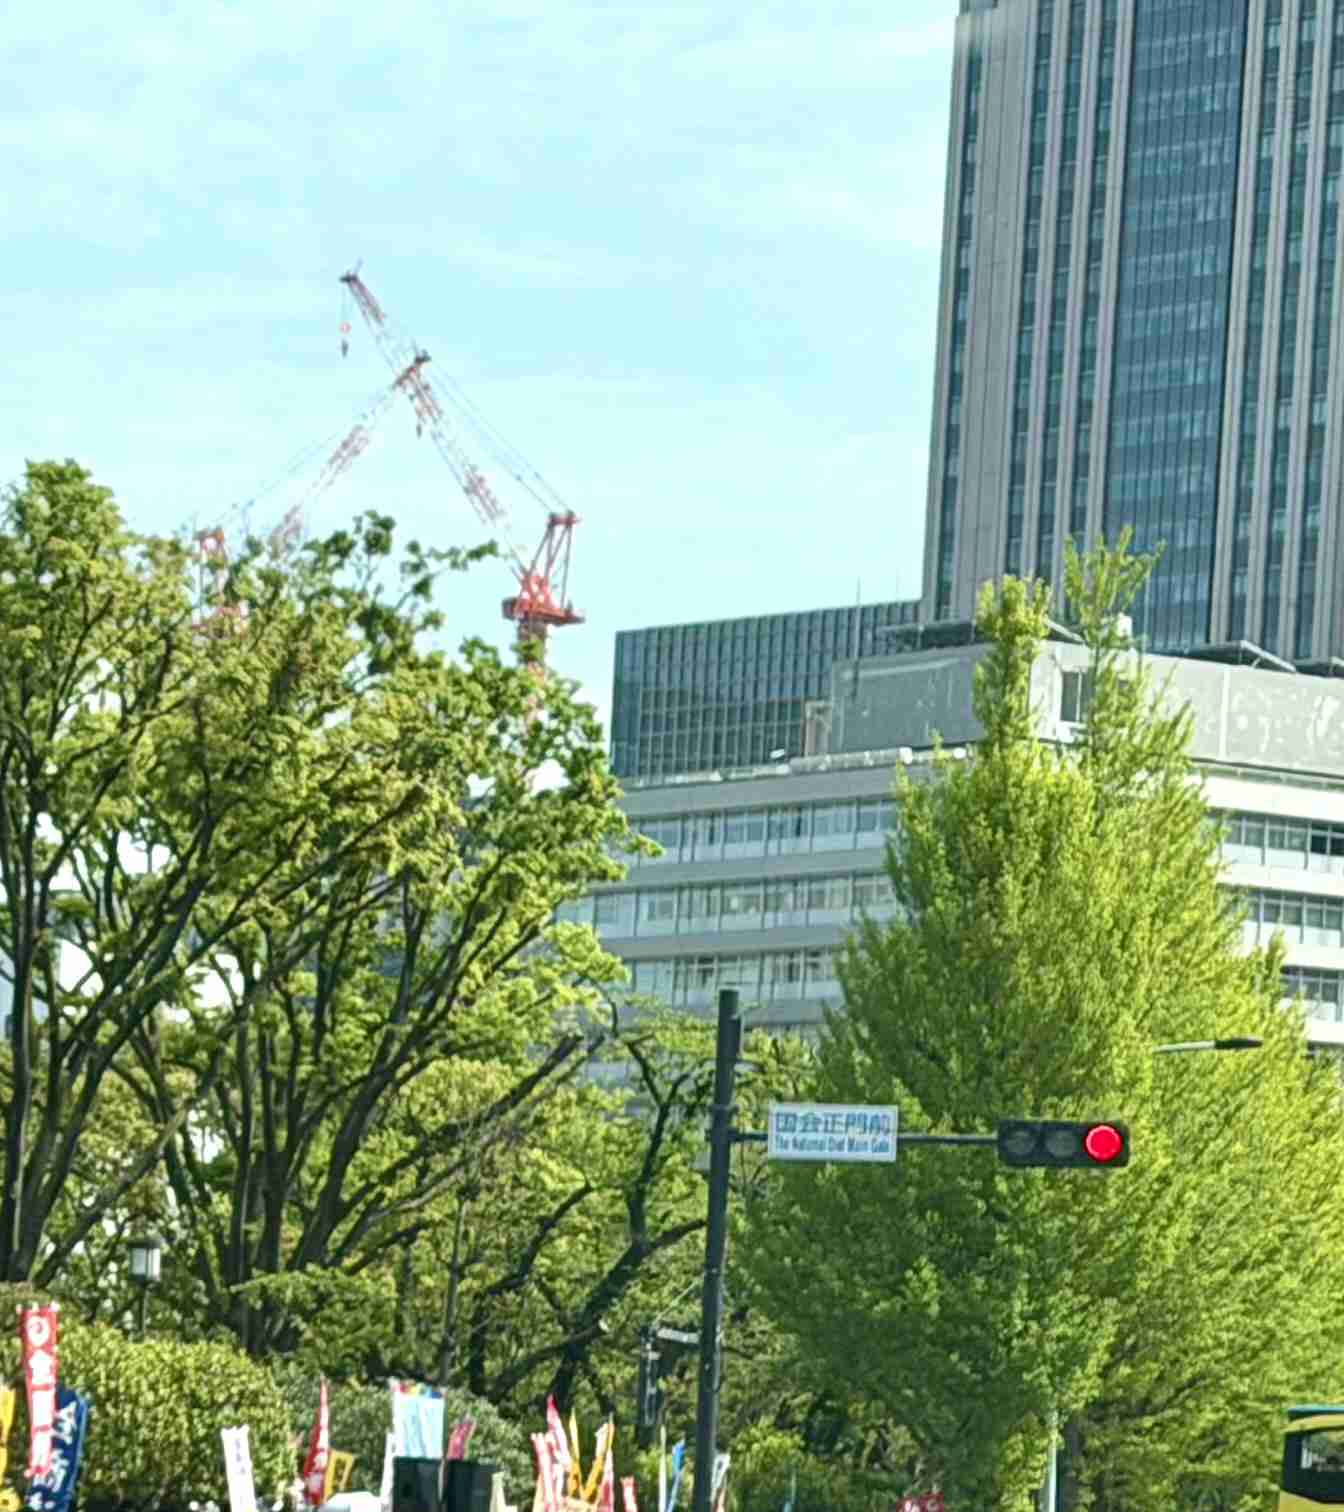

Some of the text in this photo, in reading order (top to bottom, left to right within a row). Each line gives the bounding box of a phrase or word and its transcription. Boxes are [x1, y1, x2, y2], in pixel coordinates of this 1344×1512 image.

[775, 1112, 890, 1135] 国会正門前
